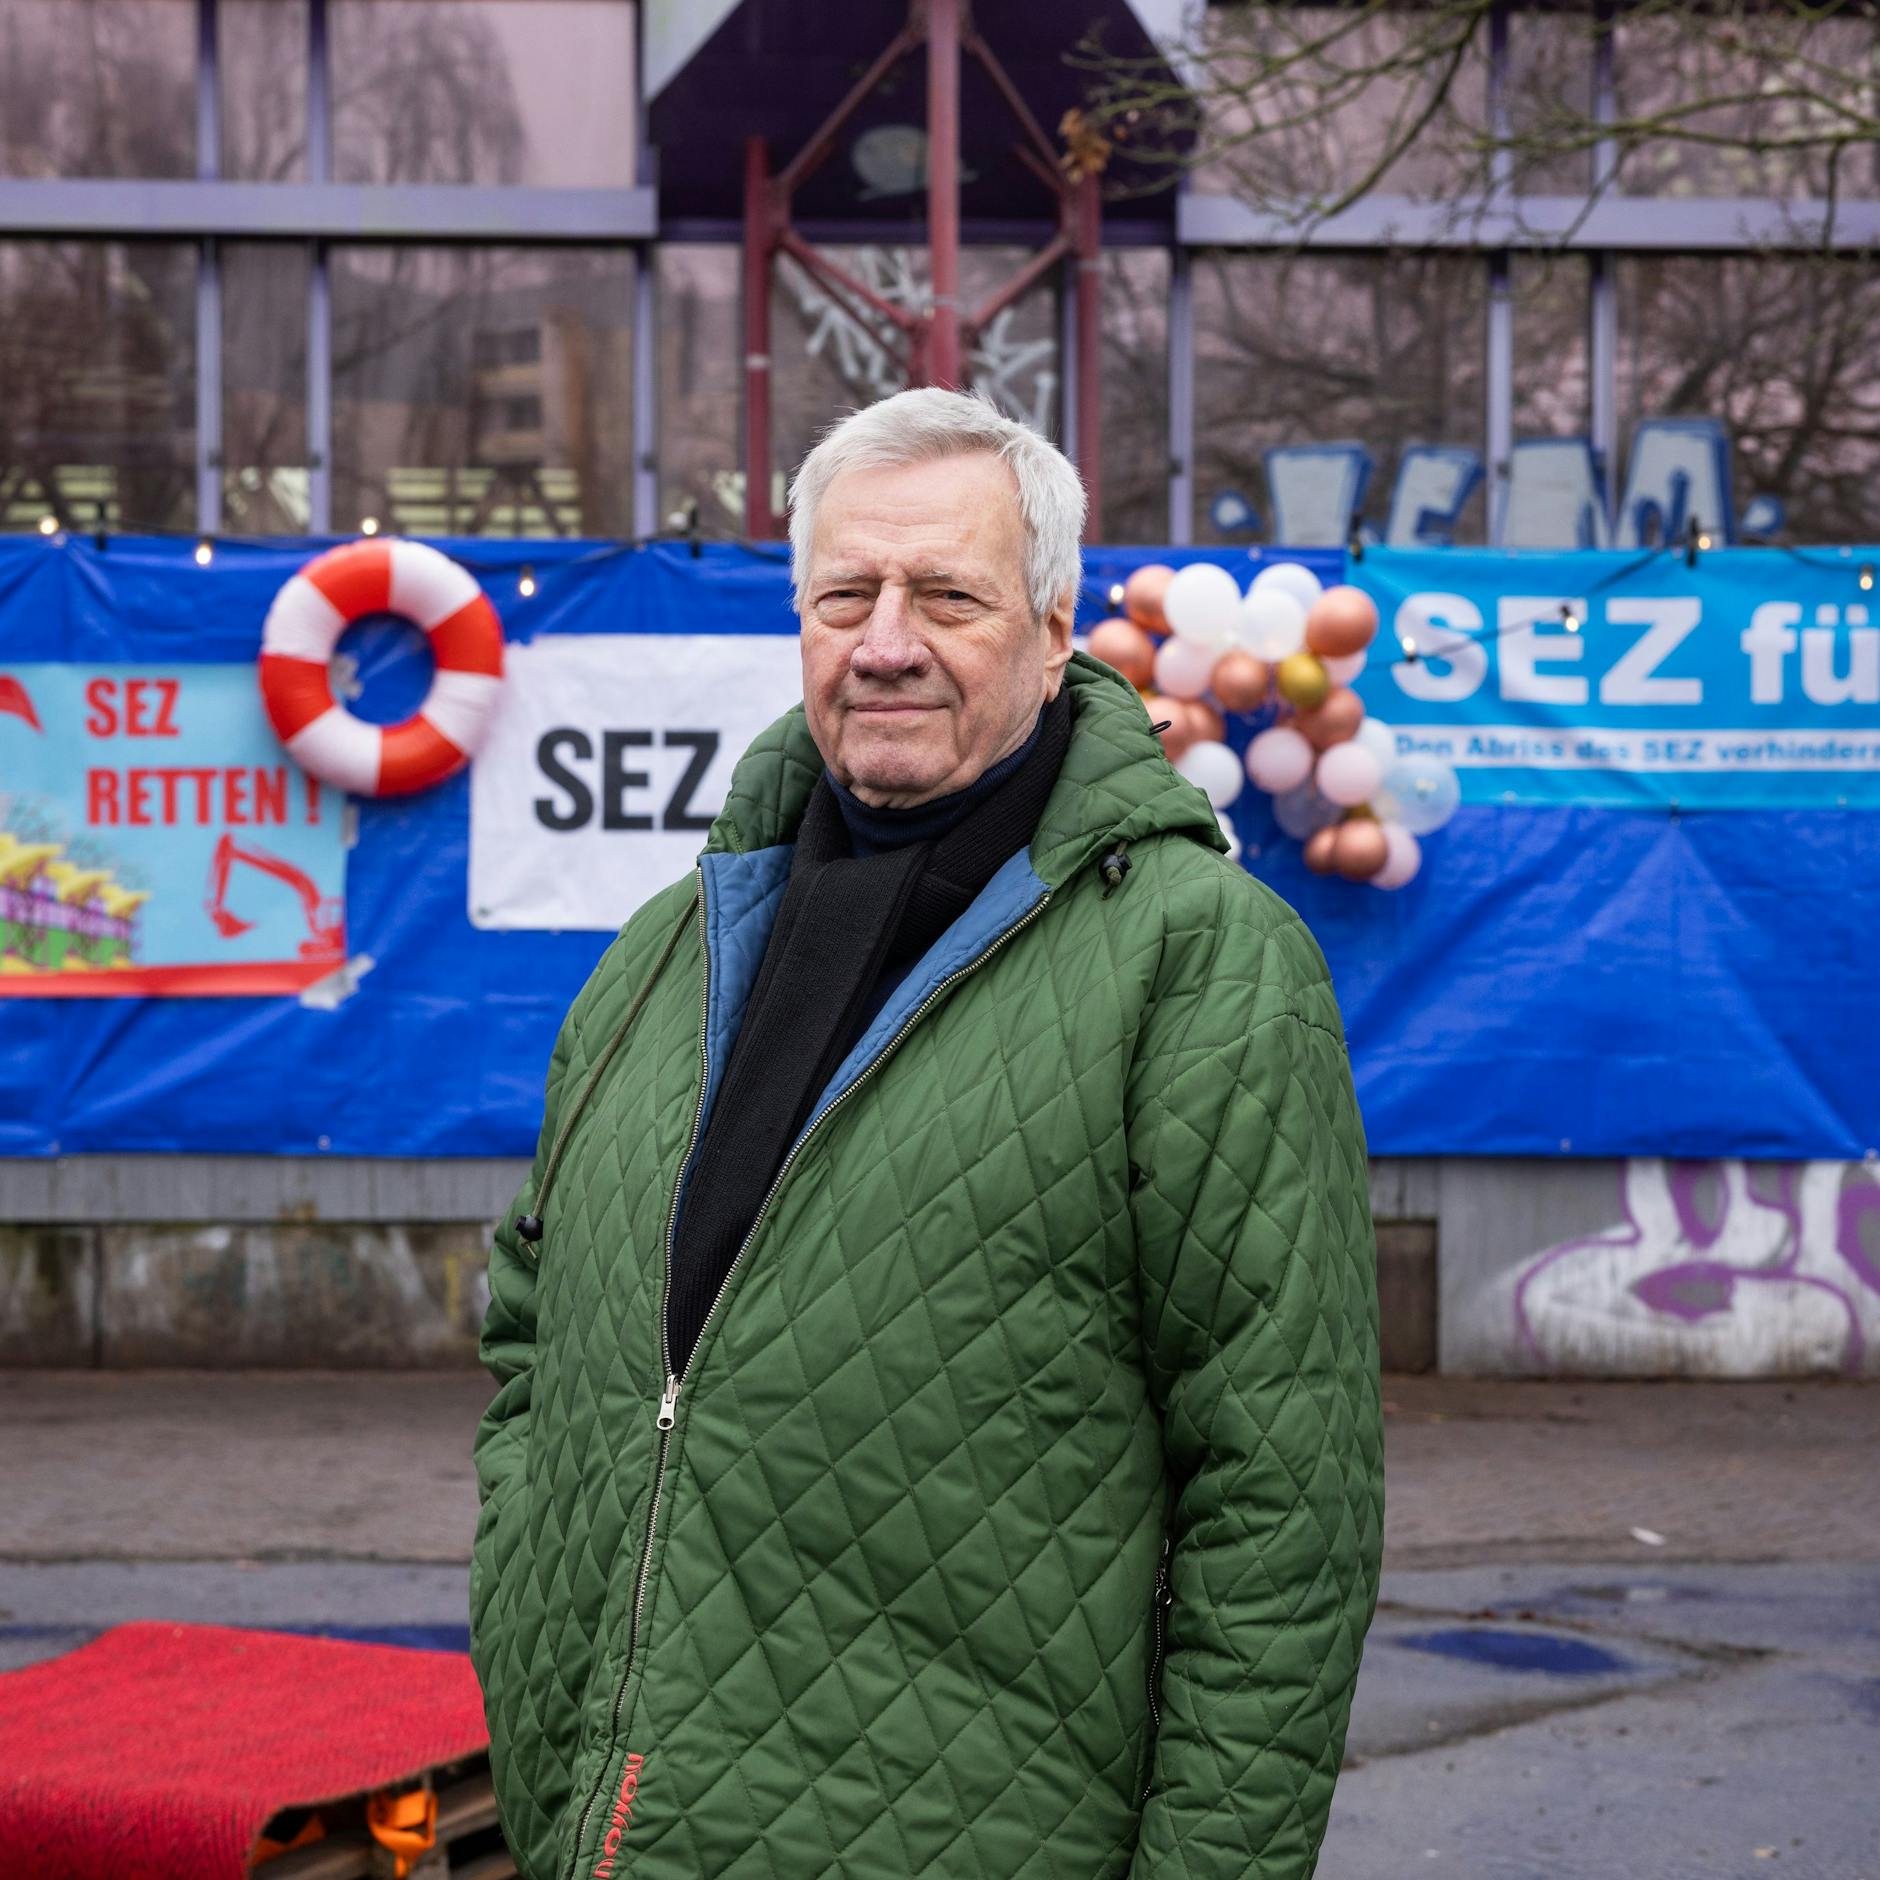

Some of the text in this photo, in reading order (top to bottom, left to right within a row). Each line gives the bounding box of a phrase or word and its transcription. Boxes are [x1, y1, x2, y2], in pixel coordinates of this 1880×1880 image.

[1391, 591, 1703, 705] SEZ
[85, 677, 181, 737] SEZ
[534, 727, 721, 832] SEZ
[1643, 739, 1703, 762] SEZ
[87, 766, 288, 826] RETTEN
